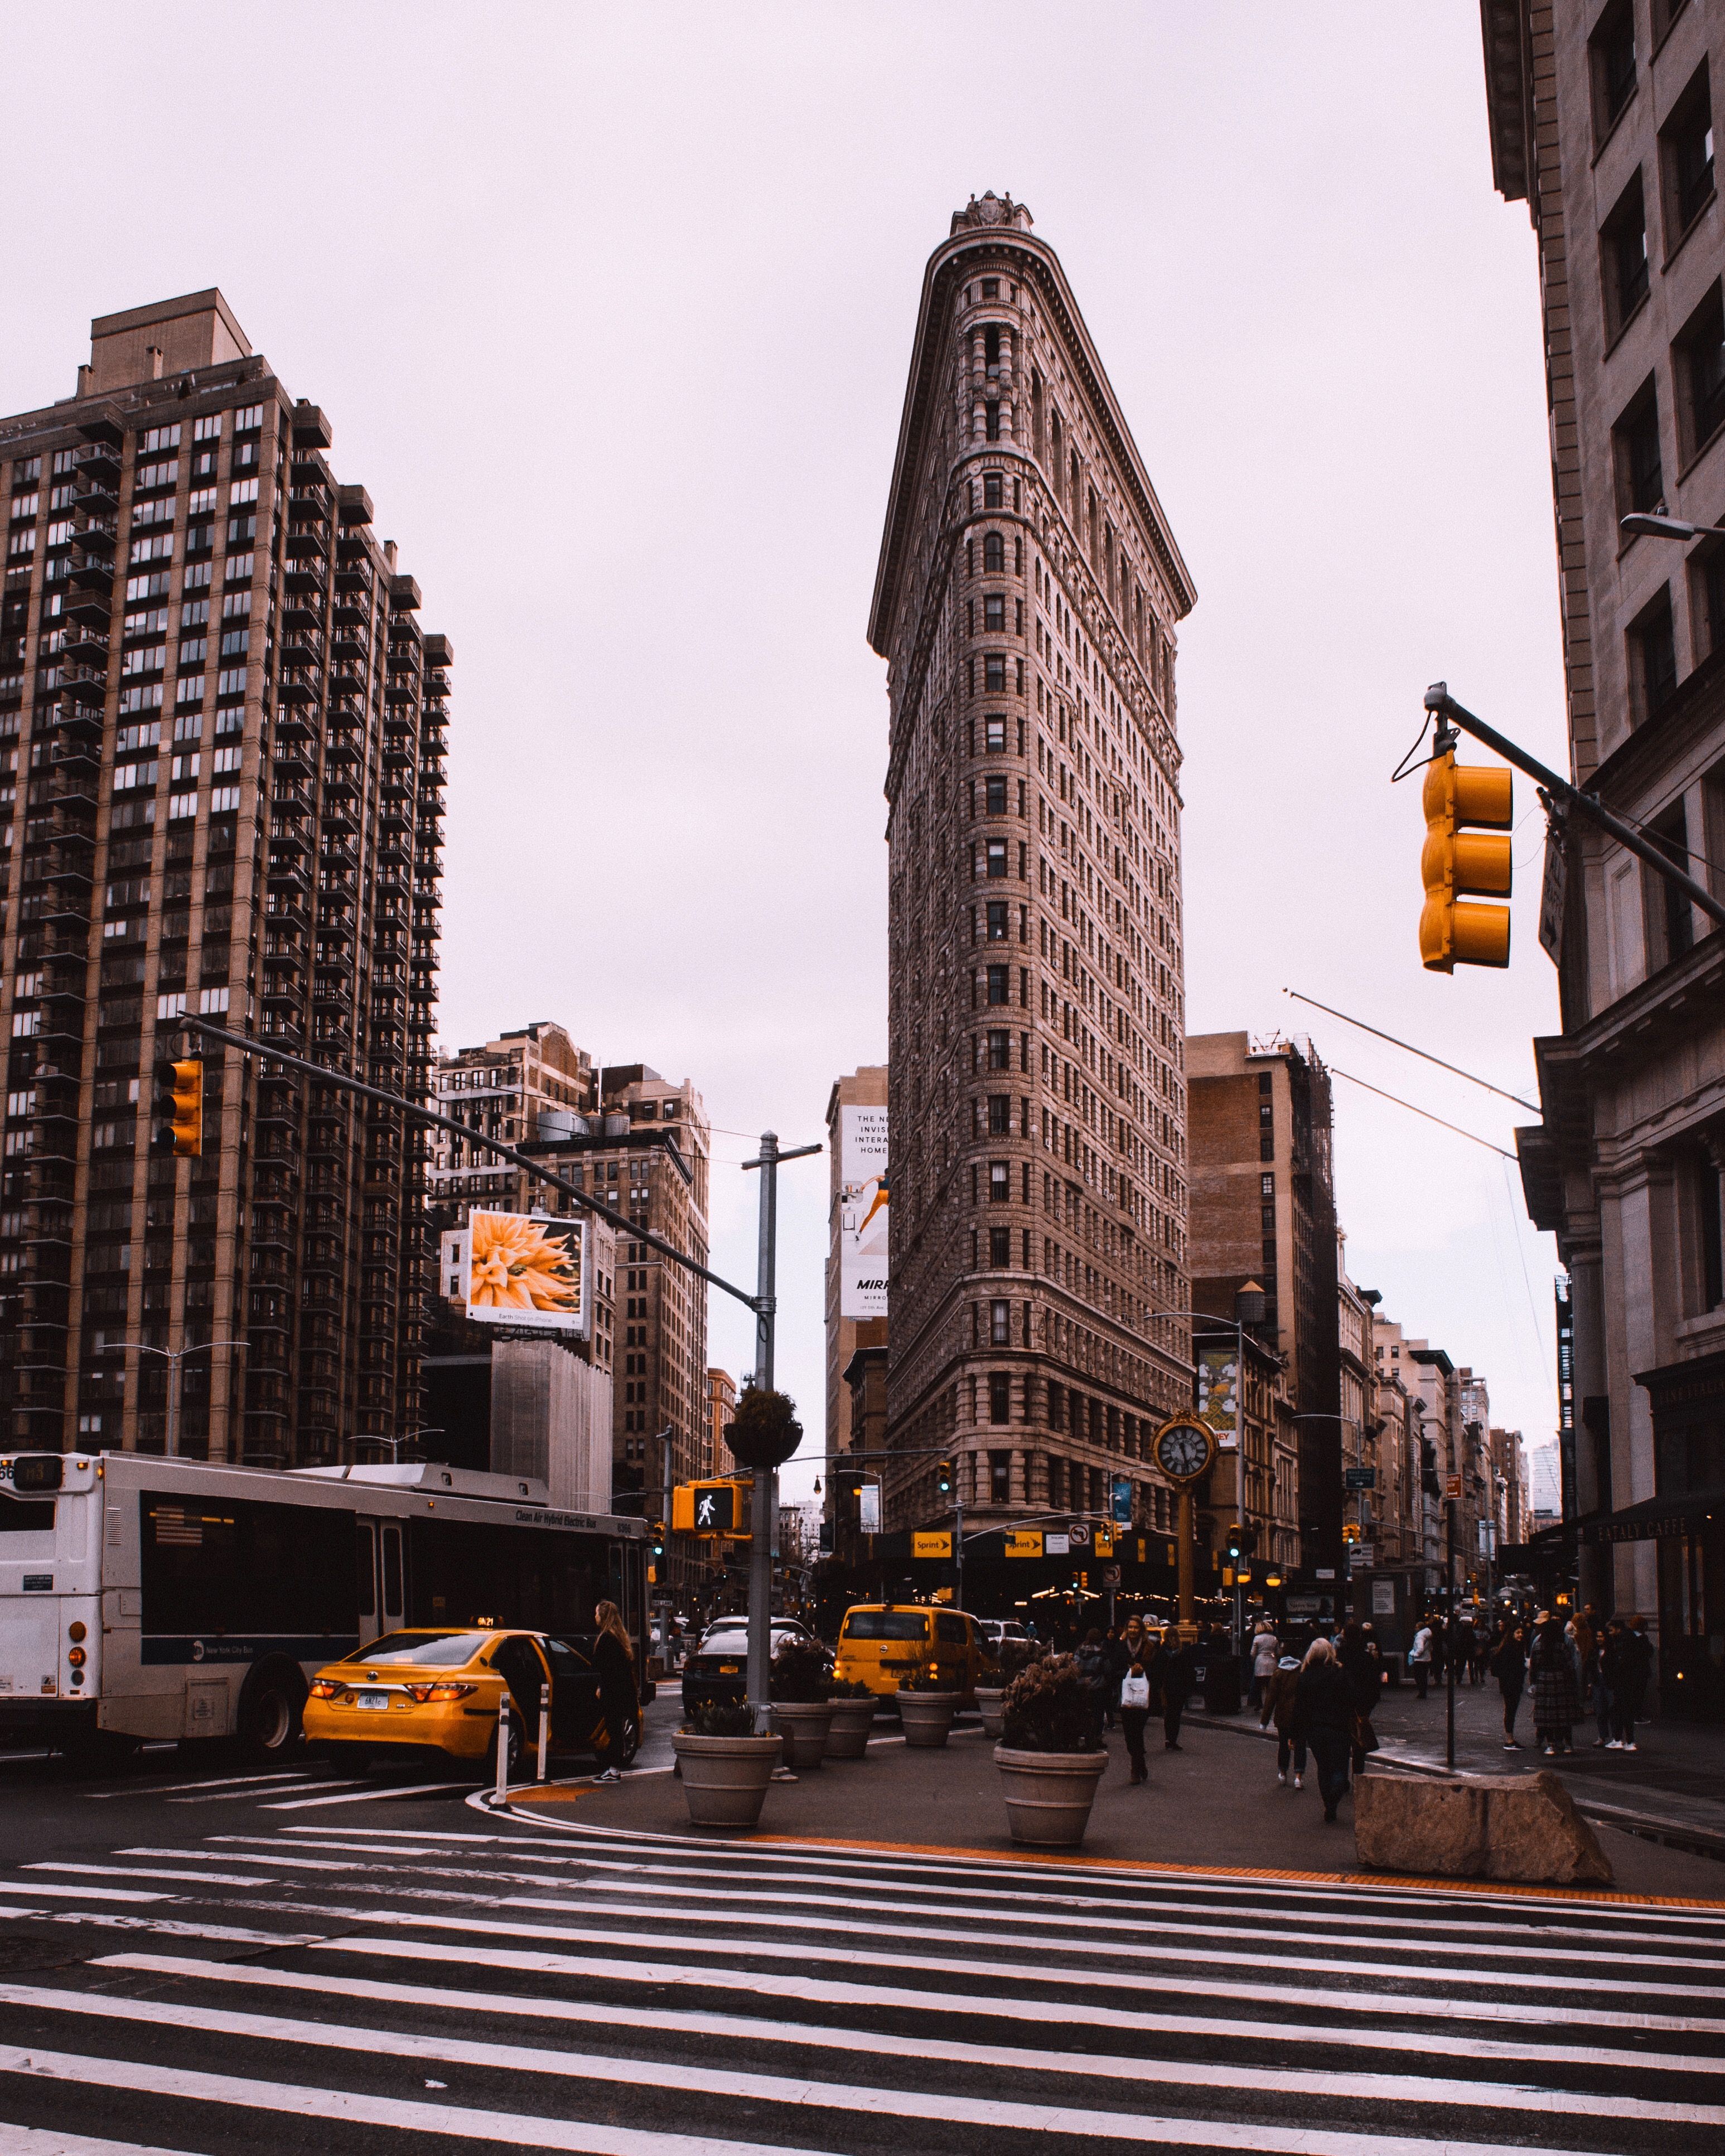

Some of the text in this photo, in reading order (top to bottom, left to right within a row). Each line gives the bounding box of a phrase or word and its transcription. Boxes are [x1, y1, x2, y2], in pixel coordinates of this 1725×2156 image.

[857, 1279, 889, 1290] MIRR
[516, 1510, 596, 1529] Clean Air Hybrid Electric Bus
[1598, 1522, 1641, 1541] EATALY
[917, 1541, 939, 1550] Sprint
[477, 1617, 494, 1626] 6N21
[231, 1646, 242, 1655] City
